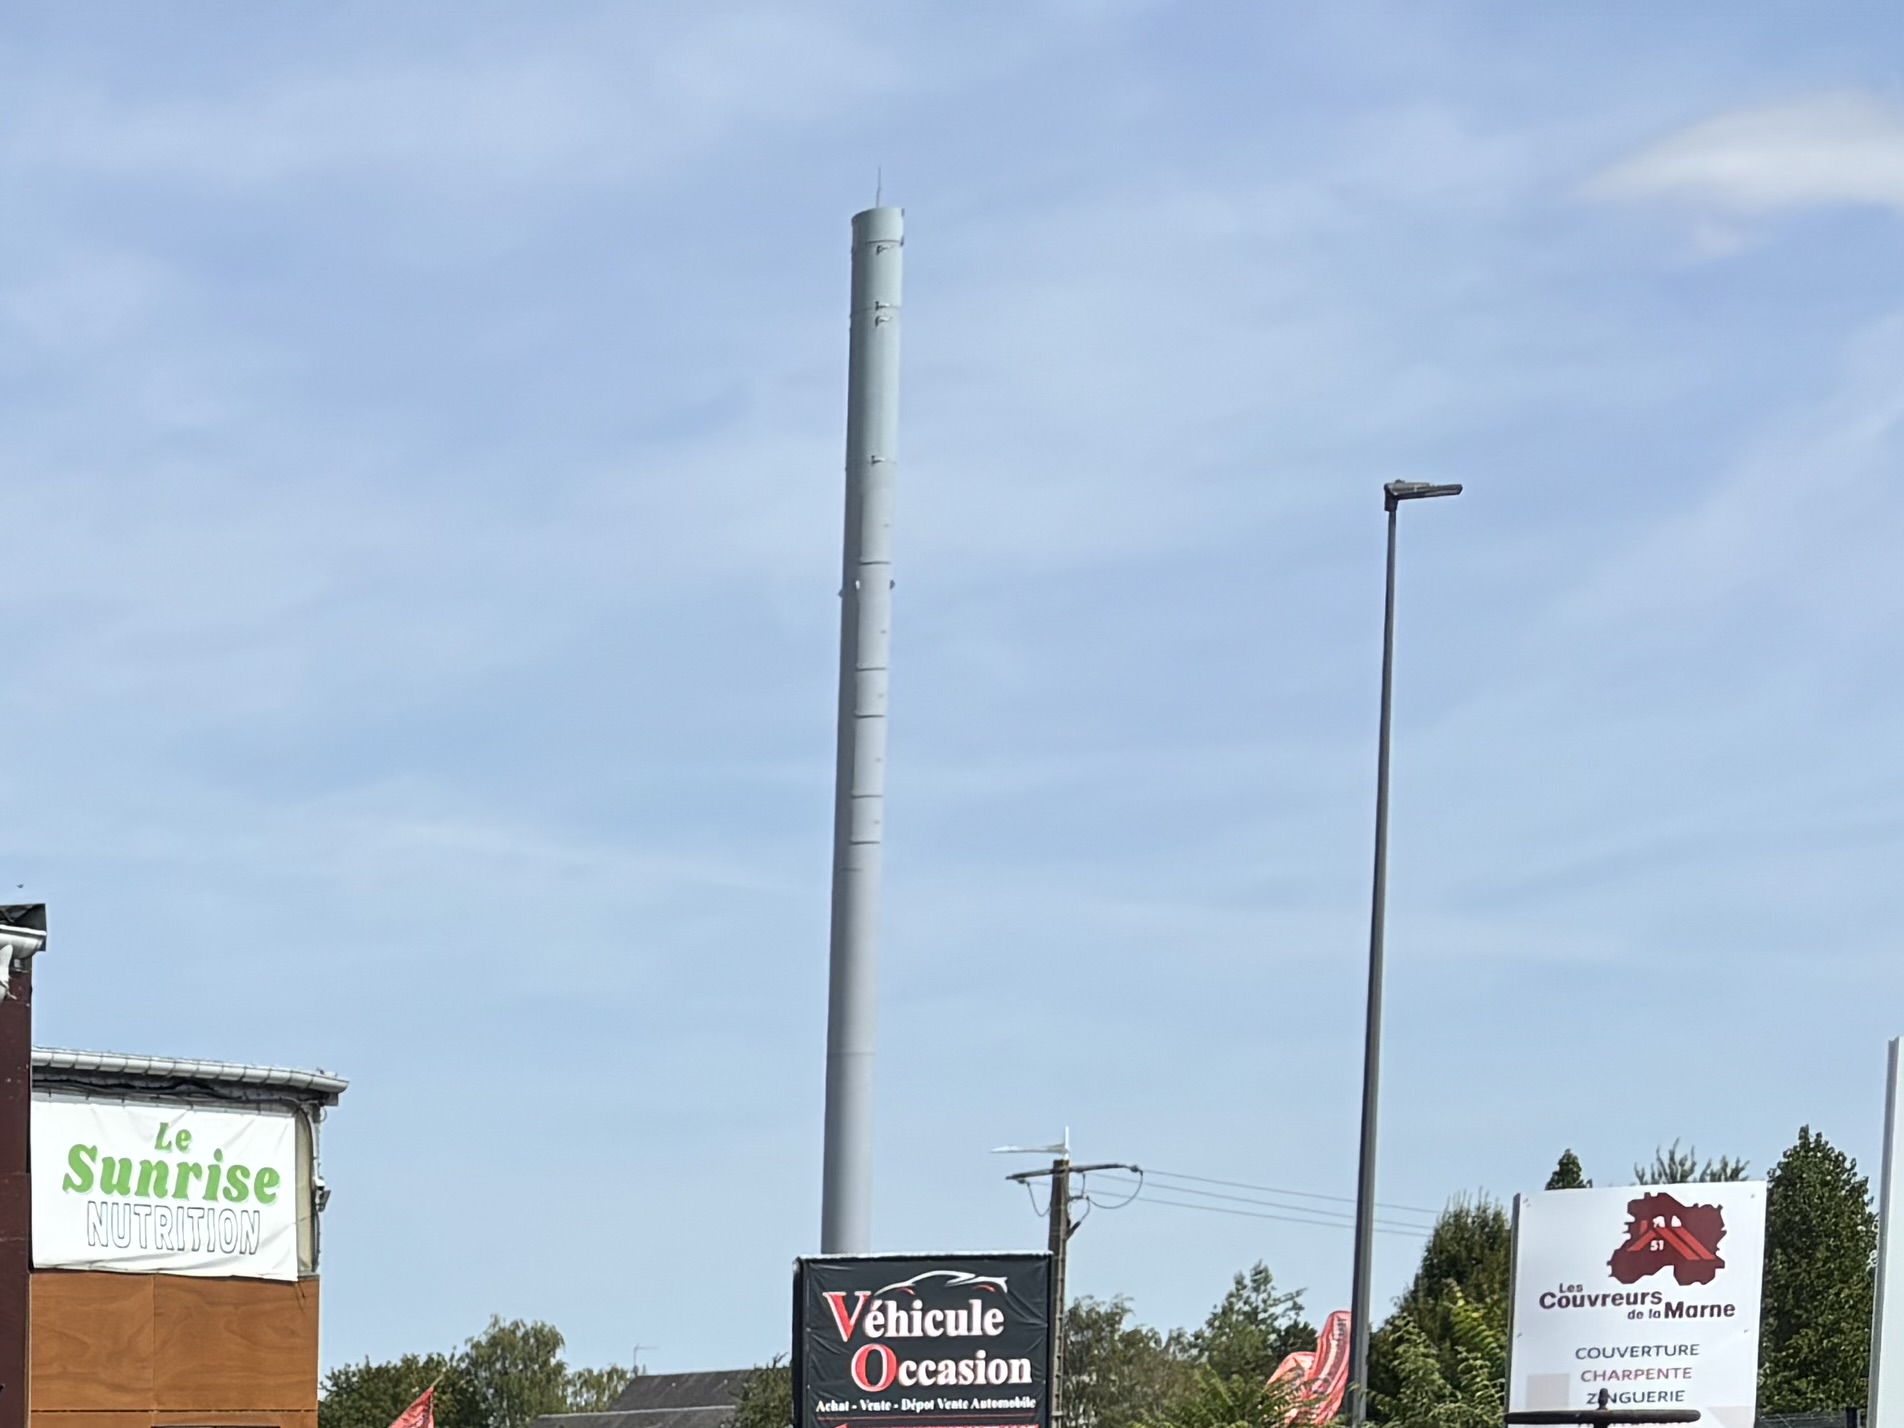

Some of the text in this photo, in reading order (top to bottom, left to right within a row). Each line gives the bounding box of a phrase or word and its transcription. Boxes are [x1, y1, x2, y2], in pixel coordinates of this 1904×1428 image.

[154, 1121, 192, 1153] Le
[62, 1143, 281, 1206] Sunrise
[86, 1200, 261, 1256] NUTRITION
[1650, 1239, 1665, 1251] 51
[1559, 1283, 1583, 1294] Les
[1539, 1290, 1663, 1310] Couvreurs
[822, 1290, 1005, 1343] Véhicule
[1627, 1301, 1736, 1320] de la Marne
[1575, 1343, 1700, 1360] COUVERTURE
[851, 1343, 1033, 1392] Occasion
[1580, 1367, 1693, 1382] CHARPENTE
[816, 1400, 849, 1412] Achat
[860, 1400, 892, 1411] Vente
[937, 1398, 969, 1411] Vente
[970, 1396, 1036, 1410] Automobile
[1586, 1390, 1686, 1405] ZNGUERIE
